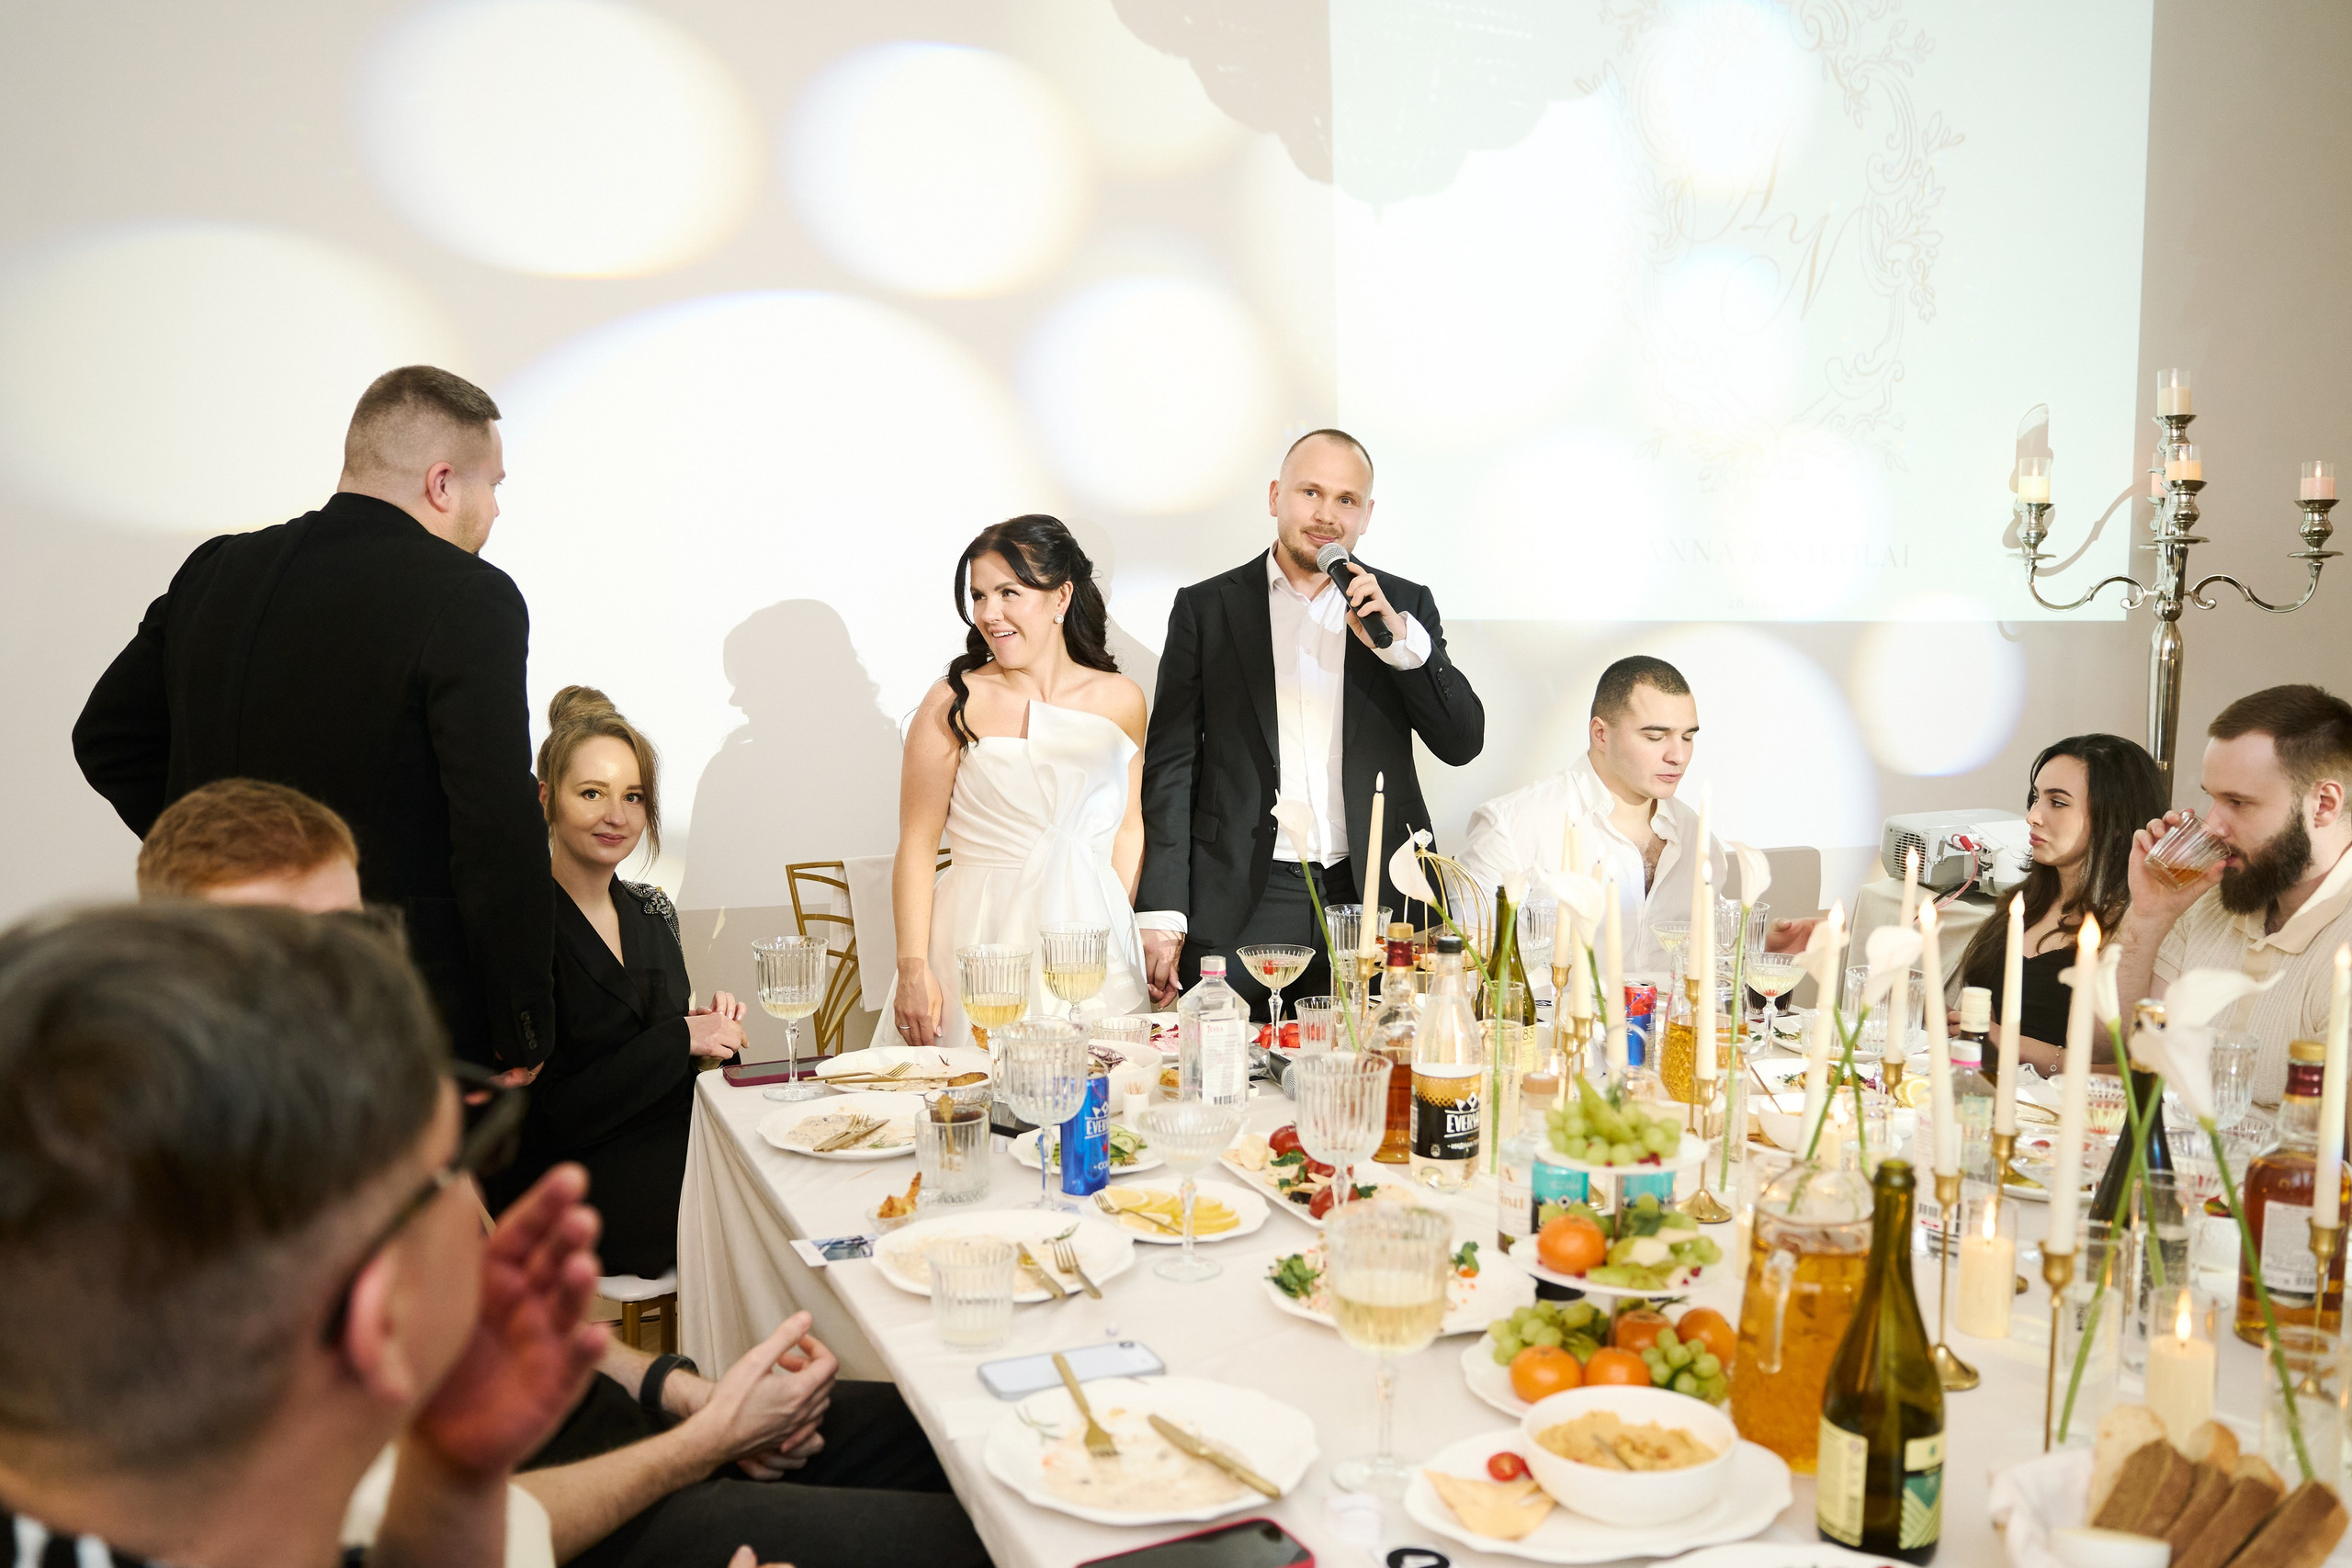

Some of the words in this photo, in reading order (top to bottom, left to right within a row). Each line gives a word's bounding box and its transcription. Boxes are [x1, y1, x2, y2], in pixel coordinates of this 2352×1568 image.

[1640, 538, 1736, 565] ANNA
[1784, 542, 1910, 568] NIKOLAI
[1086, 1119, 1109, 1135] EVER
